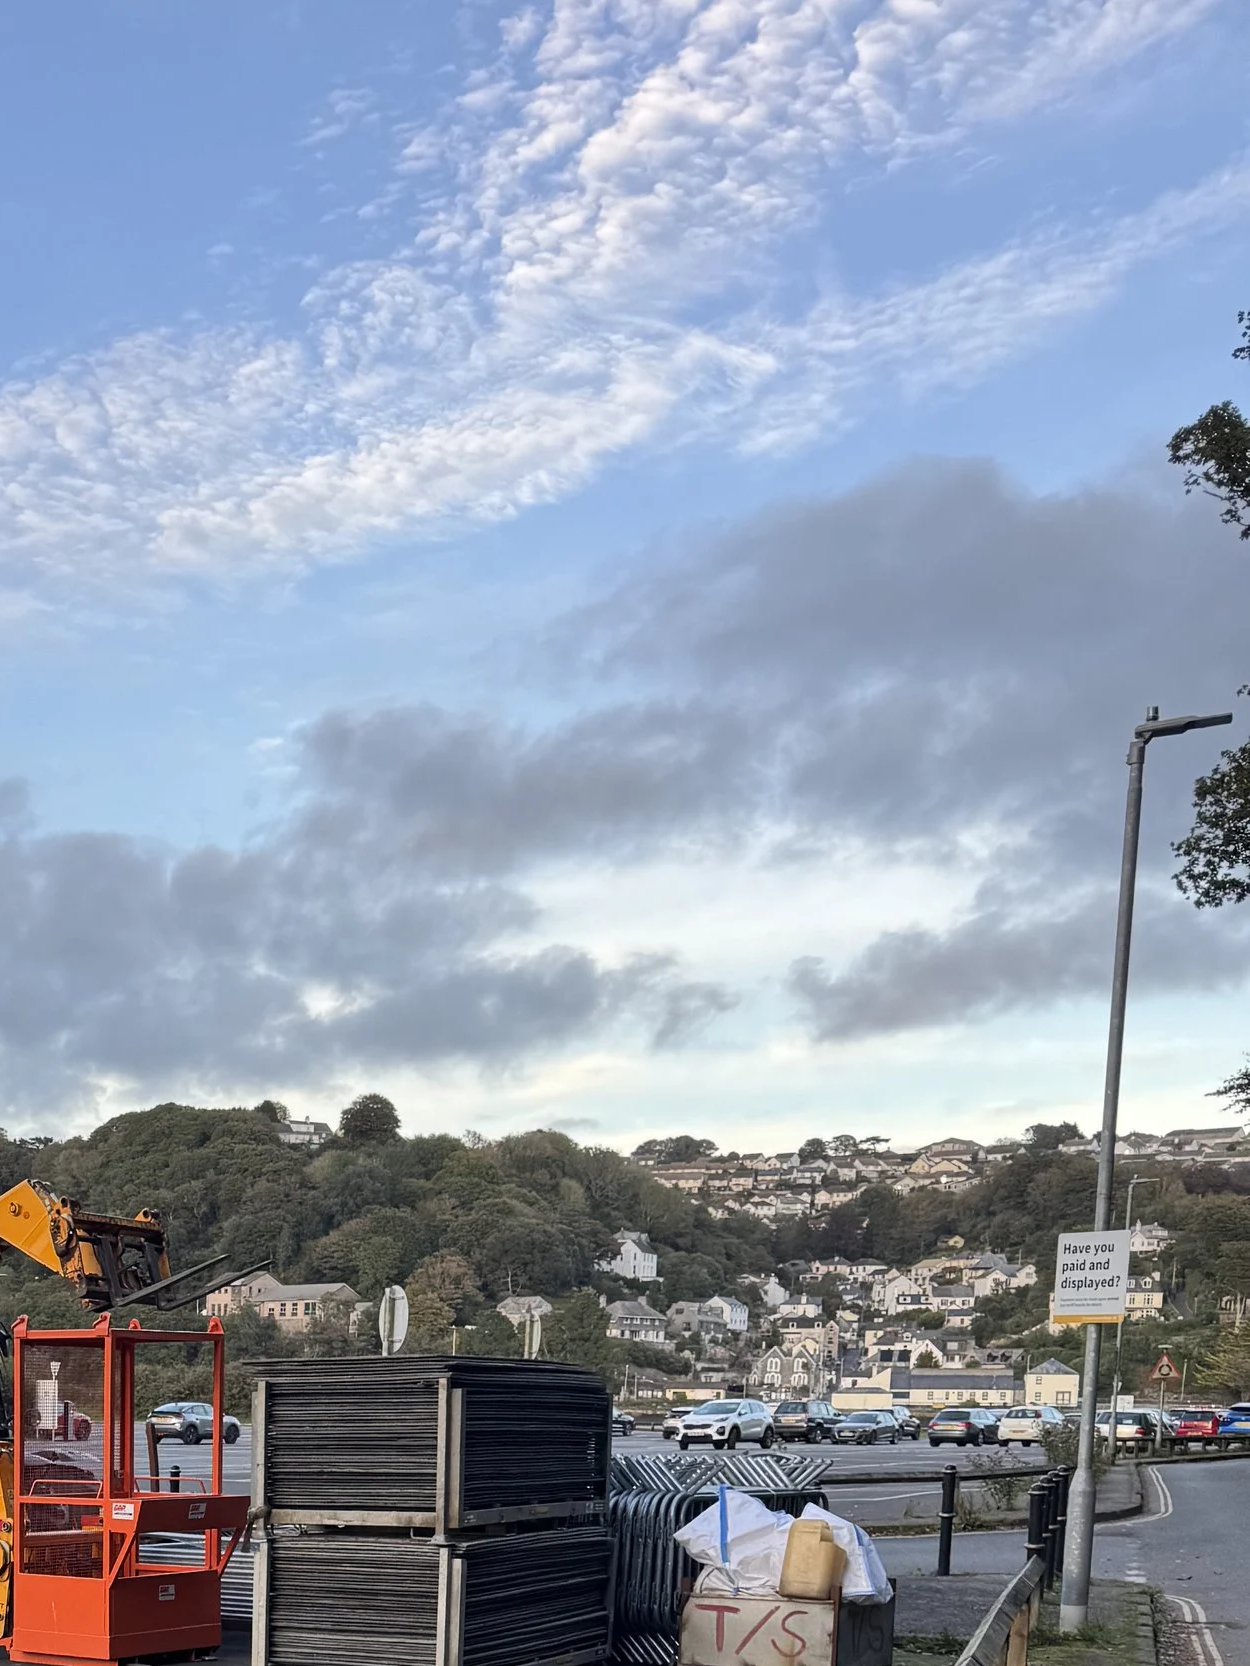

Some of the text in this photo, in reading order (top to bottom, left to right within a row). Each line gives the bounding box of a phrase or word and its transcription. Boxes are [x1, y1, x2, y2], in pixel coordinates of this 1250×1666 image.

[1063, 1243, 1115, 1256] Have you
[1062, 1258, 1110, 1274] paid and
[1061, 1276, 1120, 1291] displayed?
[695, 1604, 809, 1657] T/S
